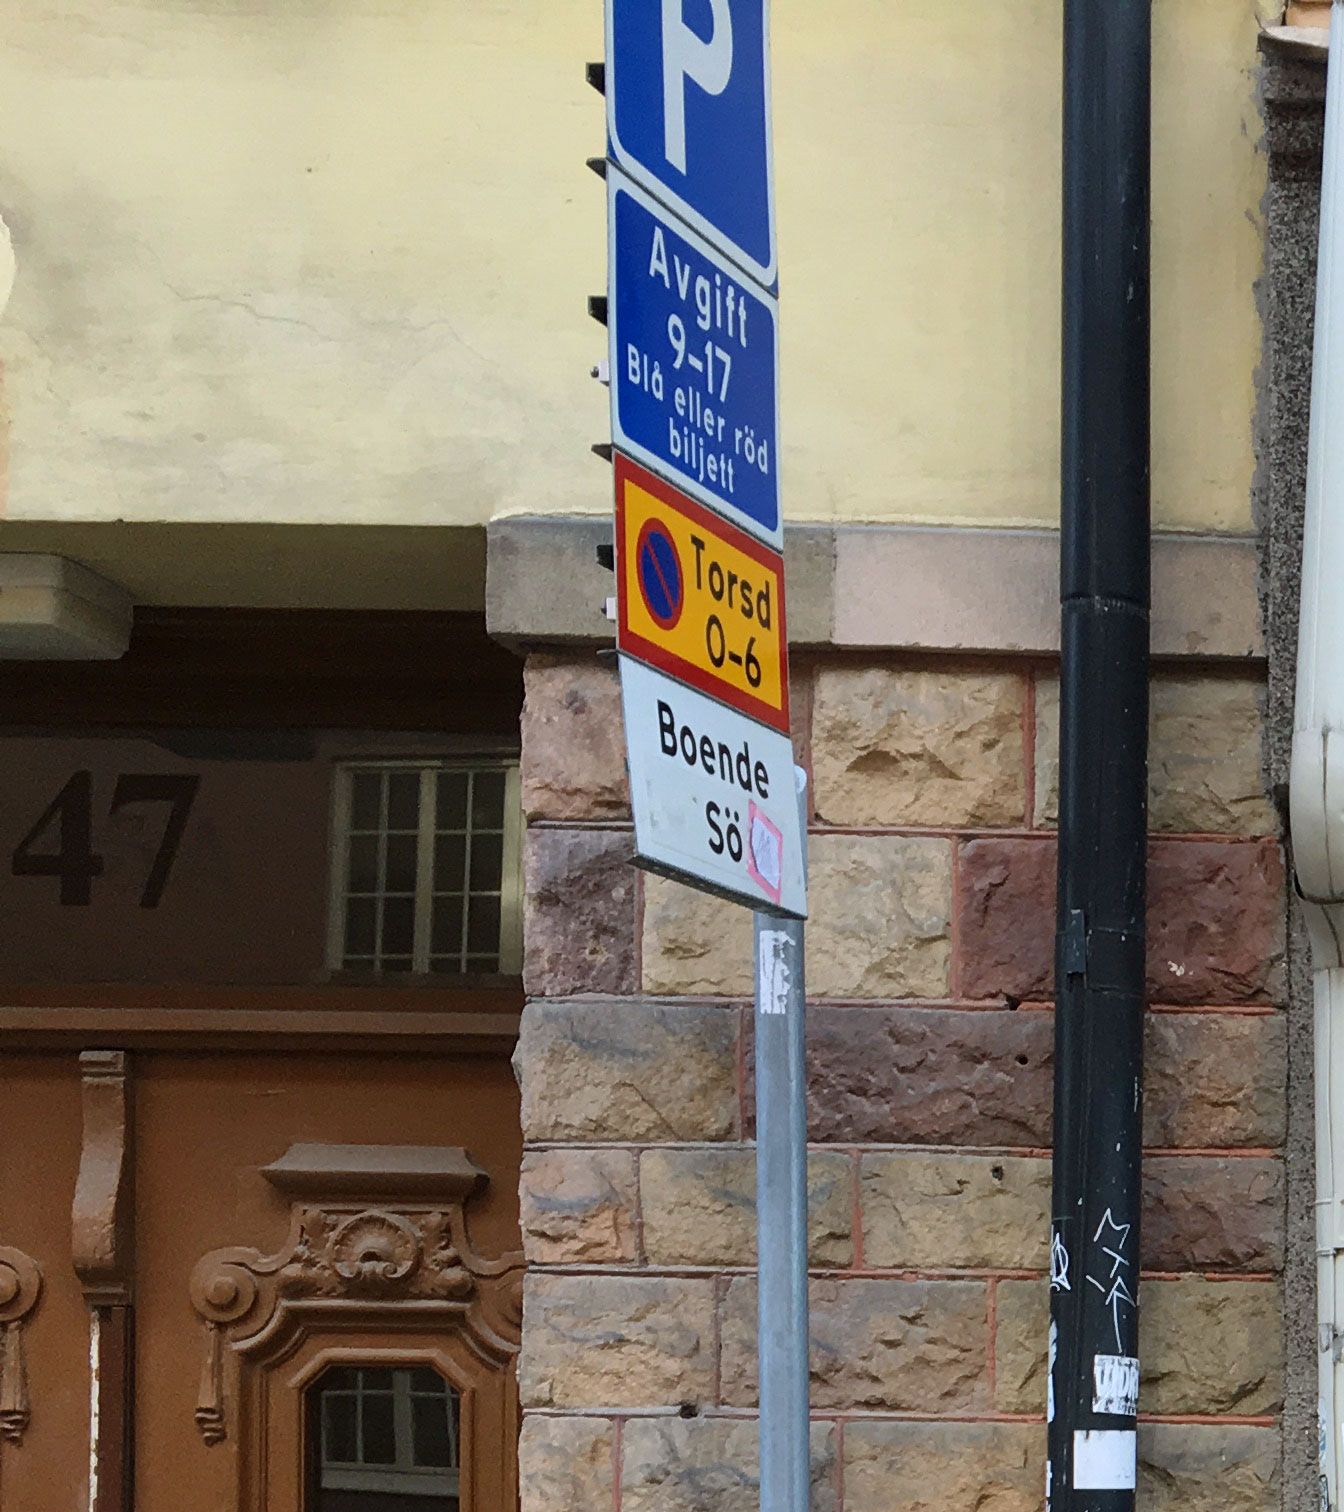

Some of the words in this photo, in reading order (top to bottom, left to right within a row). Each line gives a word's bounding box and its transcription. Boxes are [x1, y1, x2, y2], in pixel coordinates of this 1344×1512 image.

[661, 0, 733, 176] P
[649, 225, 748, 348] Avgift
[667, 312, 732, 403] 9-17
[626, 342, 664, 400] Blå
[673, 386, 726, 444] eller
[735, 424, 768, 475] röd
[668, 416, 735, 494] biljett
[690, 536, 772, 631] Torsd
[705, 613, 762, 690] 0-6
[656, 699, 770, 800] Boende
[11, 768, 202, 909] 47
[706, 800, 743, 863] Sö
